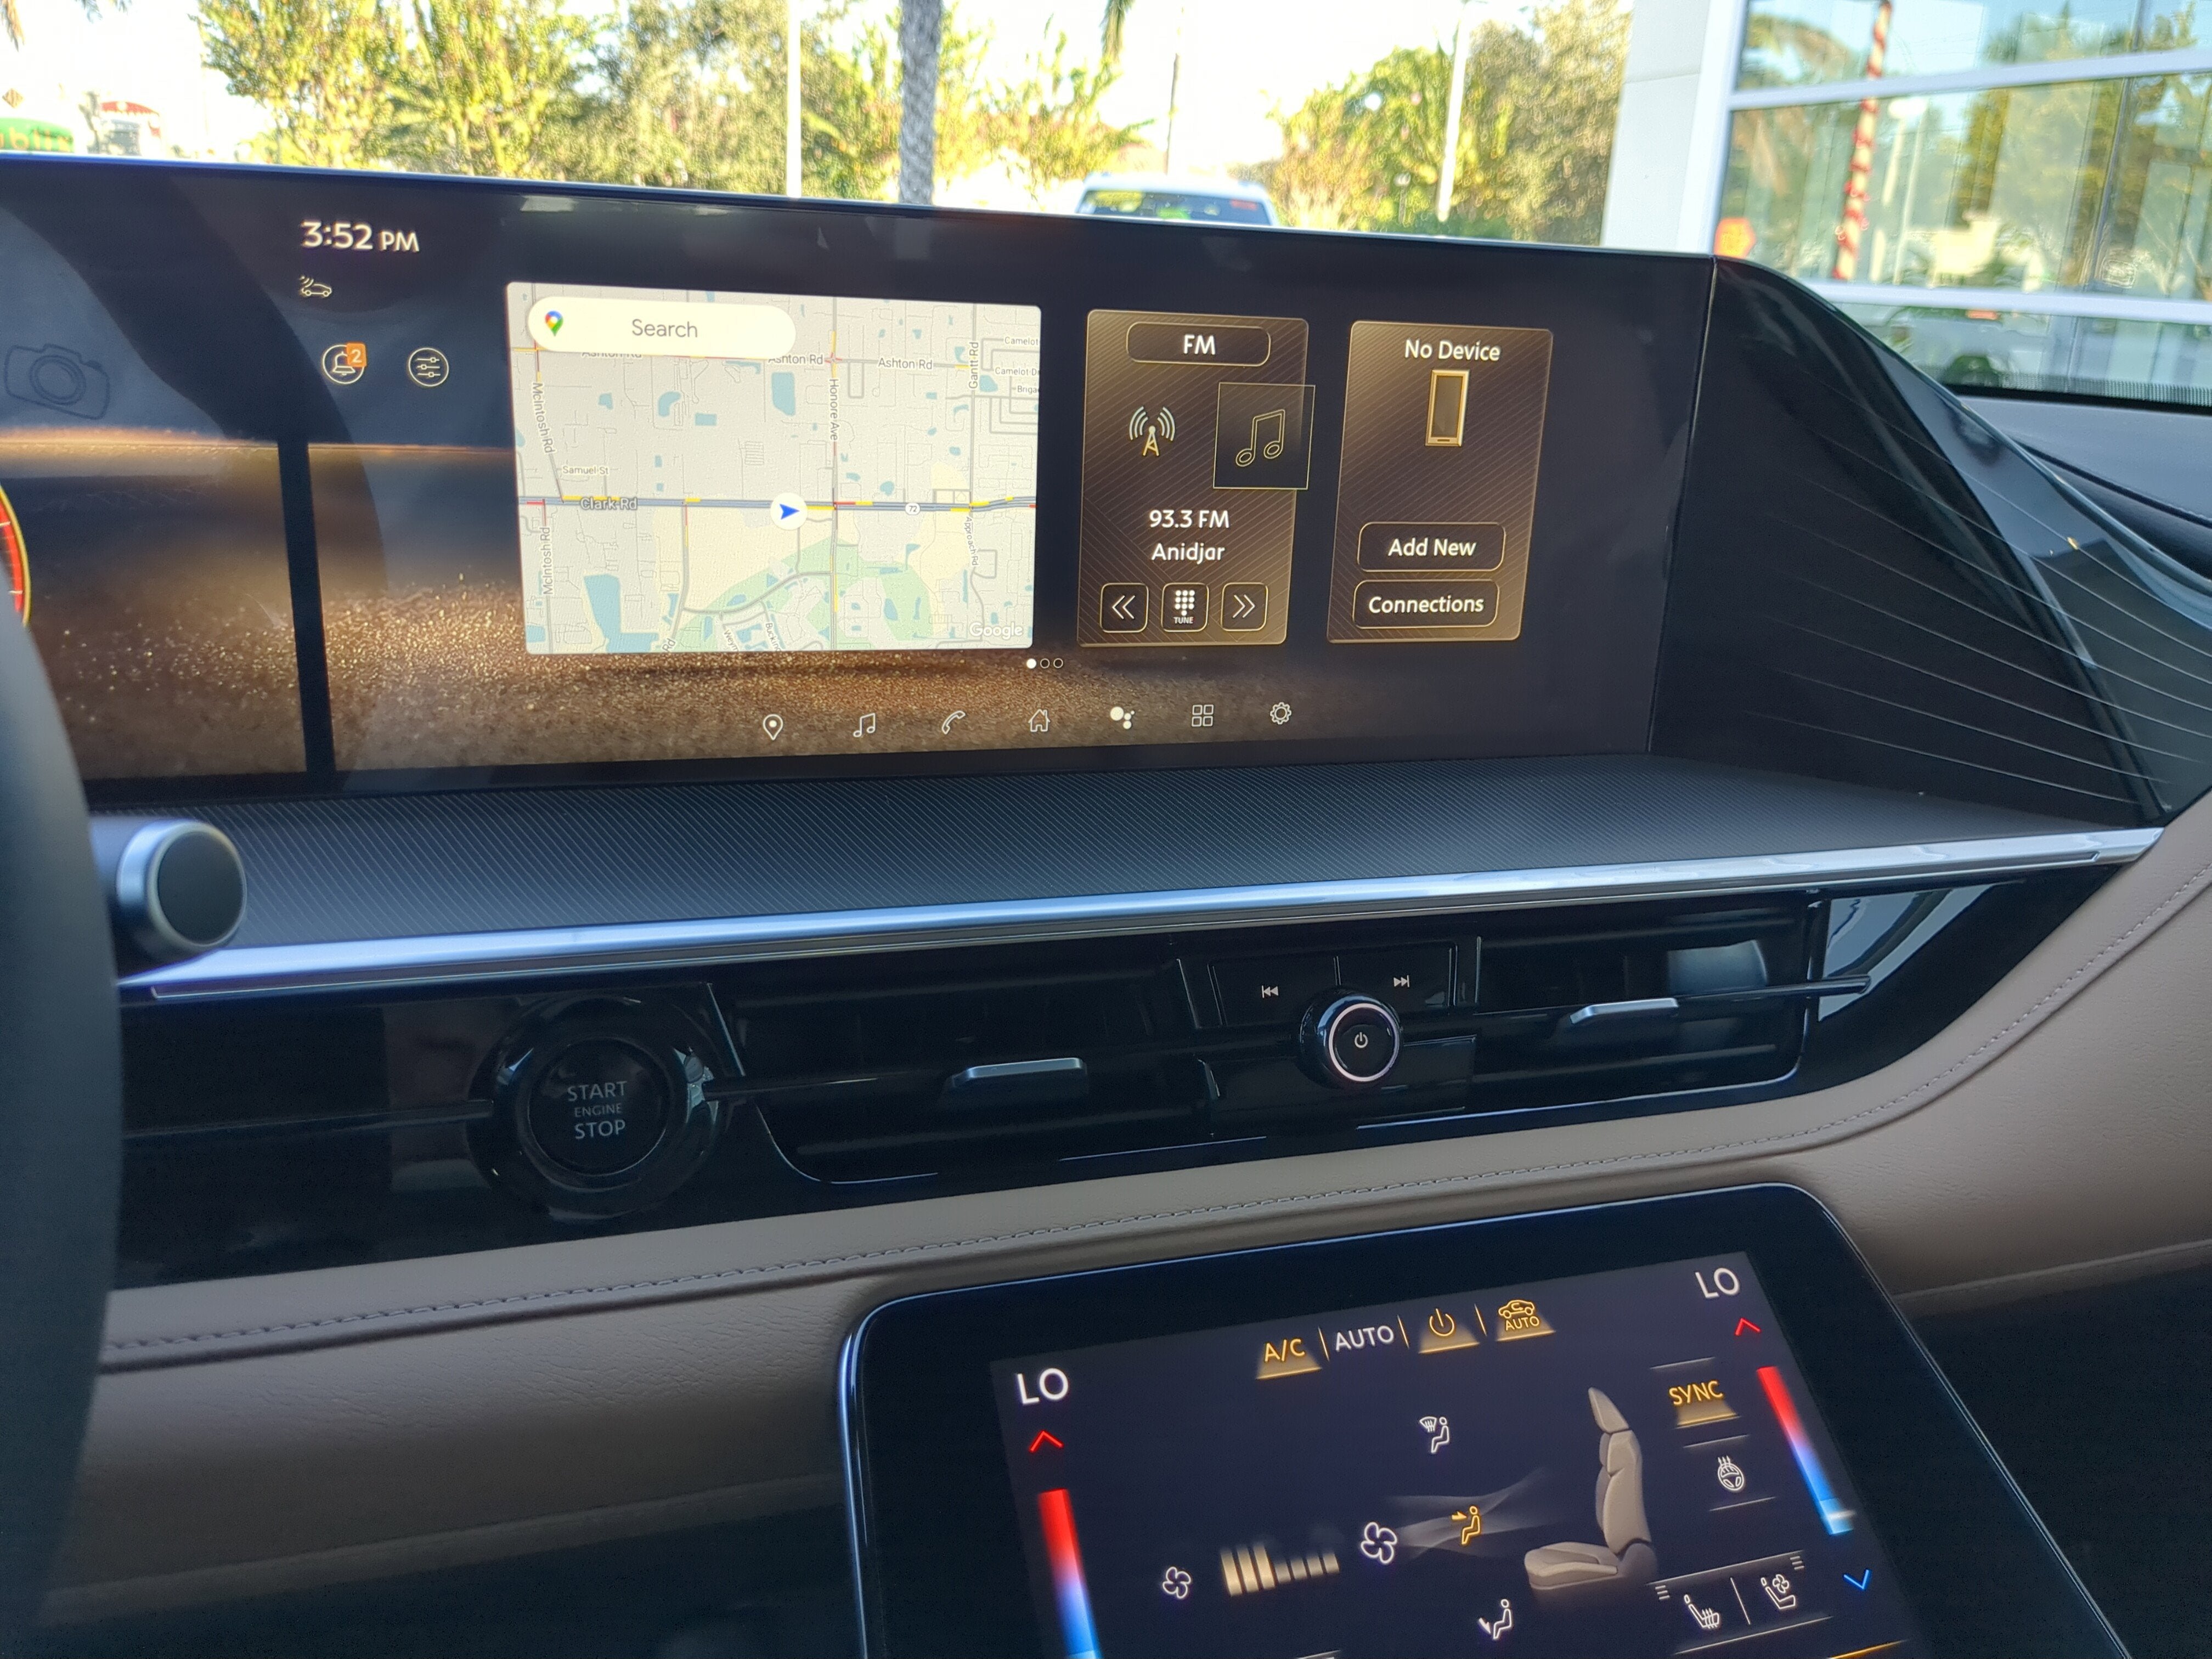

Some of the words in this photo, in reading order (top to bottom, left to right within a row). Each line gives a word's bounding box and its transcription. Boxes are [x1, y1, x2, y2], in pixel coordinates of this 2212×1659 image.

[301, 222, 373, 250] 3:52
[379, 230, 419, 252] PM
[632, 319, 697, 337] Search
[969, 342, 979, 356] Rd
[1005, 336, 1038, 345] Camelot
[1183, 335, 1216, 355] FM
[1404, 339, 1432, 359] No
[1438, 341, 1500, 361] Device
[351, 349, 362, 363] 2
[810, 354, 822, 364] Rd
[878, 358, 915, 369] Ashton
[919, 359, 932, 369] Rd
[969, 359, 978, 389] Gantt
[995, 367, 1028, 376] Camelot
[830, 379, 839, 419] Honore
[1018, 385, 1039, 394] Briga
[533, 383, 550, 438] McIntosh
[543, 438, 555, 453] Rd
[831, 422, 839, 441] Ave
[580, 498, 616, 510] Clark
[620, 498, 637, 510] Rd
[1149, 510, 1193, 528] 93.3
[1199, 510, 1229, 528] FM
[539, 527, 550, 541] Rd
[964, 517, 977, 555] Approach
[971, 556, 979, 566] Rd
[1151, 542, 1225, 565] Anidjar
[1388, 538, 1429, 557] Add
[1434, 539, 1477, 557] New
[540, 545, 553, 594] McIntosh
[1368, 596, 1484, 613] Connections
[969, 622, 1023, 640] Google
[662, 638, 675, 652] Rd
[567, 1081, 628, 1102] START
[574, 1102, 622, 1117] ENGINE
[574, 1119, 626, 1139] STOP
[1695, 1268, 1740, 1300] LO
[1505, 1316, 1539, 1332] AUTO
[1335, 1325, 1394, 1352] AUTO
[1263, 1338, 1306, 1363] A/C
[1017, 1367, 1069, 1404] LO
[1669, 1380, 1723, 1406] SYNC
